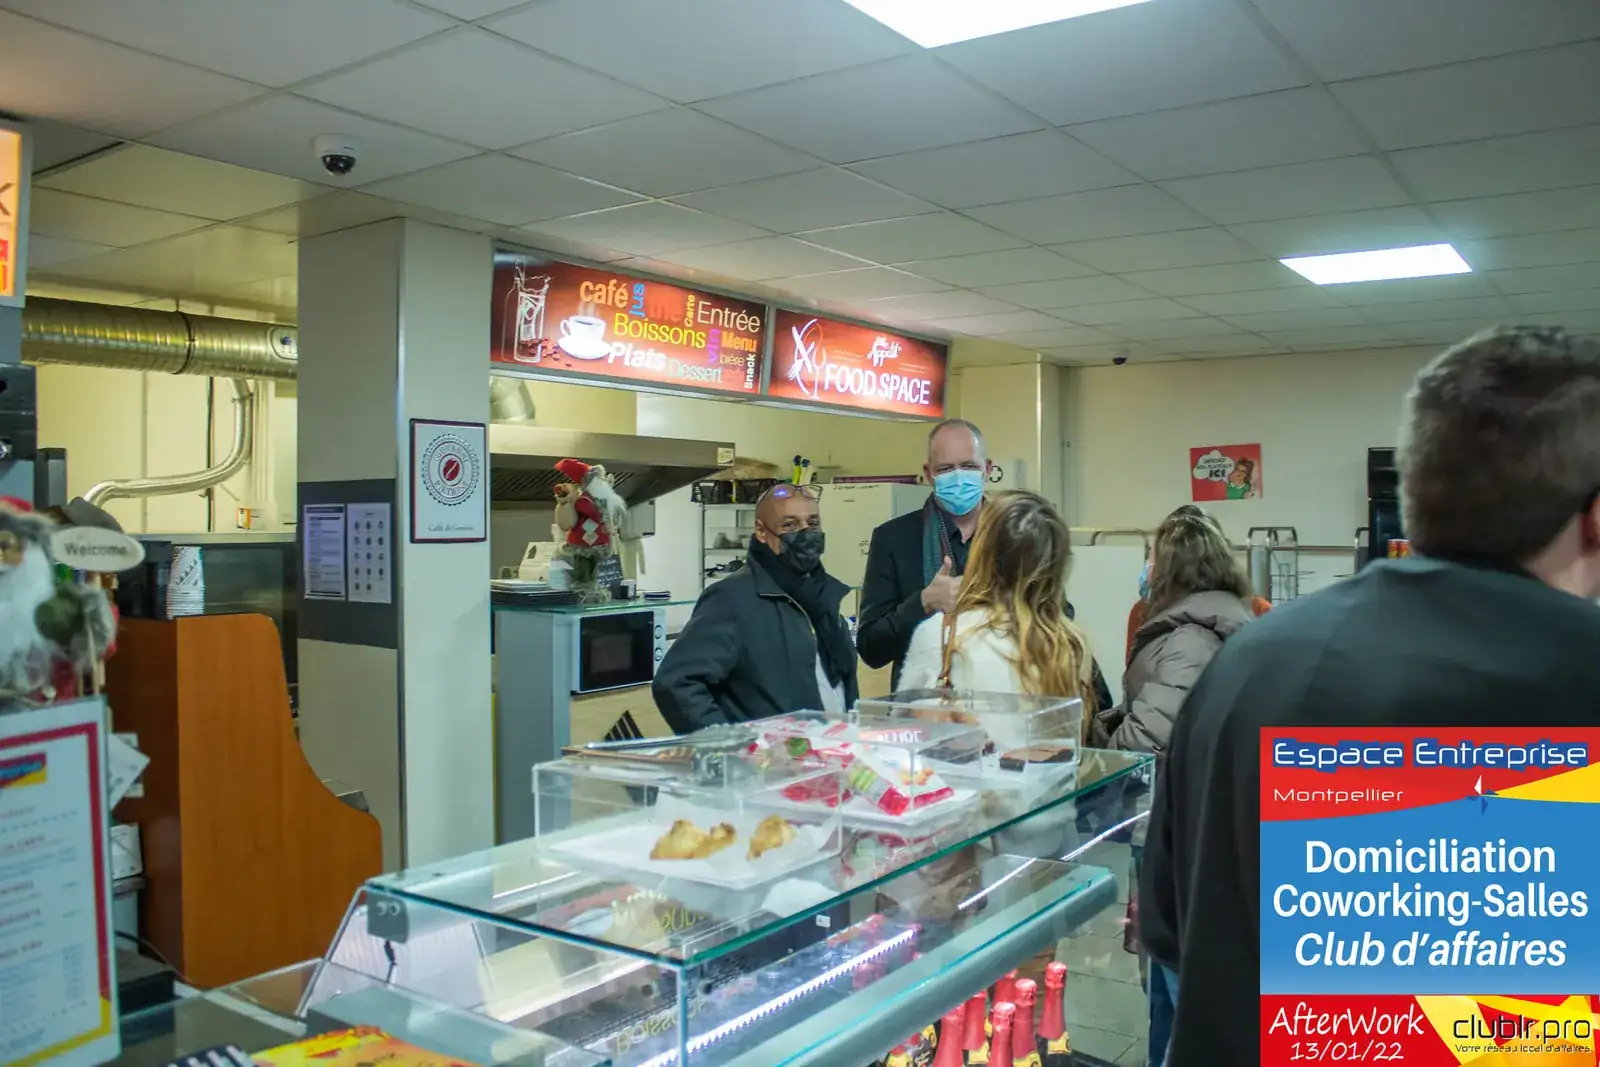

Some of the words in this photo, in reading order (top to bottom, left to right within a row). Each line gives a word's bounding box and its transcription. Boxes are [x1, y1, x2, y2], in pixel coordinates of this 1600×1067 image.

[579, 279, 629, 308] café
[629, 283, 645, 318] jus
[684, 294, 696, 327] Carte
[697, 301, 761, 333] Entrée
[613, 313, 707, 349] Boissons
[707, 328, 721, 365] vin
[721, 331, 757, 352] Menu
[607, 341, 667, 371] Plats
[667, 358, 723, 384] Dessert
[743, 353, 756, 389] Snack
[824, 363, 876, 396] FOOD
[878, 372, 931, 405] SPACE
[64, 541, 128, 557] Welcome
